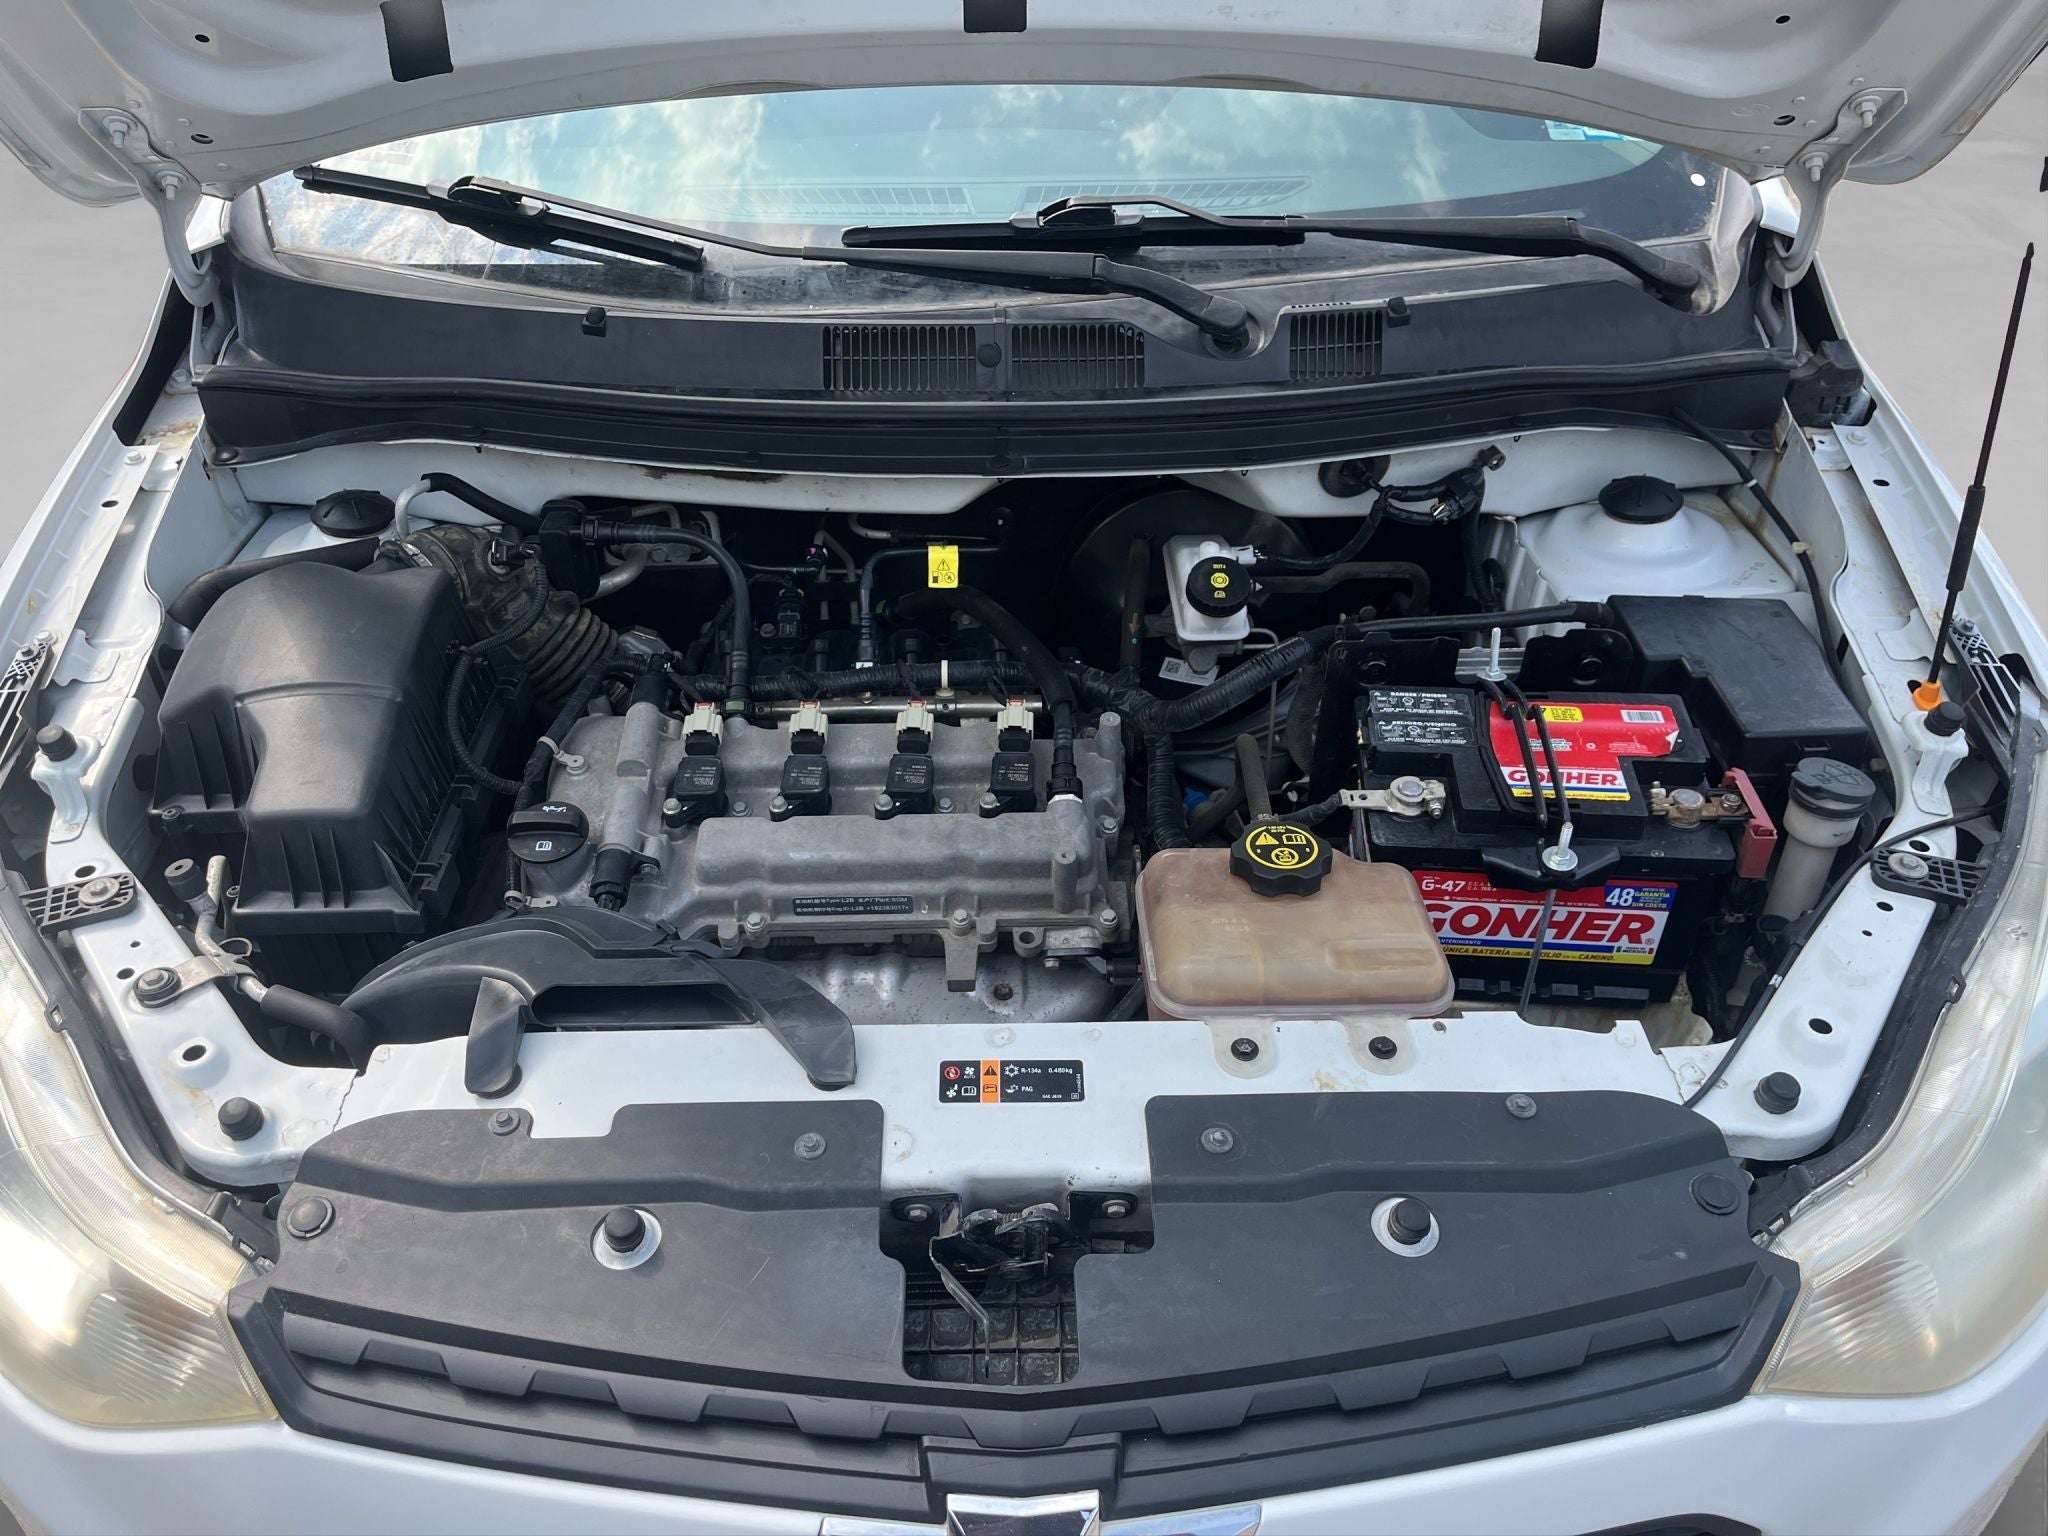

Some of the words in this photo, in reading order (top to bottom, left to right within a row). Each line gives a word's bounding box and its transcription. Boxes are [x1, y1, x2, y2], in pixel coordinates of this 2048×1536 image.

[1421, 879, 1466, 892] G-47
[1605, 887, 1635, 907] 48
[1425, 903, 1655, 945] GONHER
[1442, 945, 1470, 953] ÚNICA
[1471, 947, 1510, 956] BATERÍA
[1523, 950, 1562, 959] AILIO
[1578, 953, 1616, 962] CAMINO.
